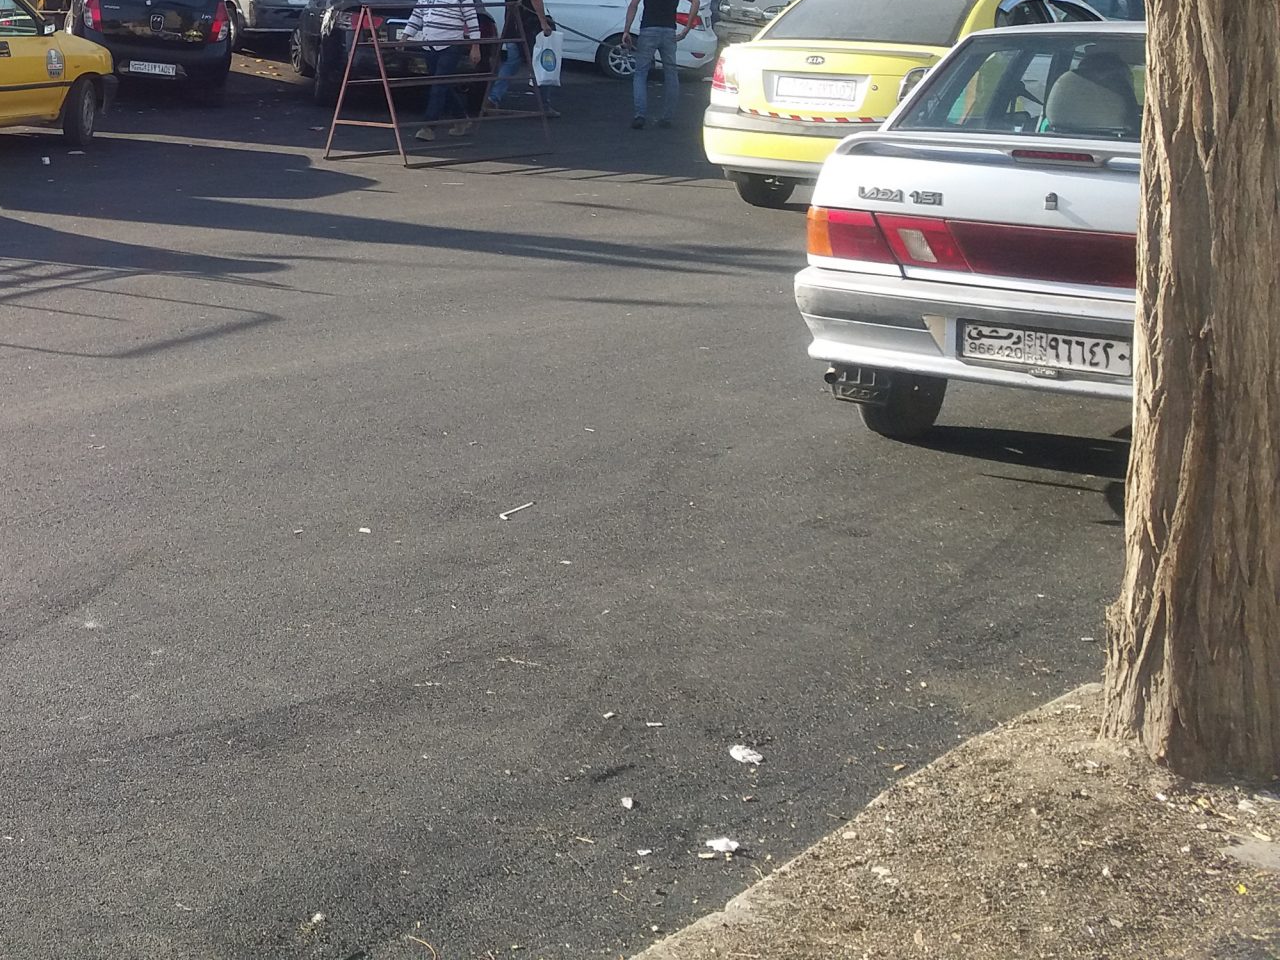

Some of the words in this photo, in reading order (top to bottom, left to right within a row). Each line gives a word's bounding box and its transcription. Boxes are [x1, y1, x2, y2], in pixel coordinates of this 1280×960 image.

[858, 185, 905, 203] LADA
[967, 327, 1021, 346] دمشق
[969, 341, 1023, 359] 966420
